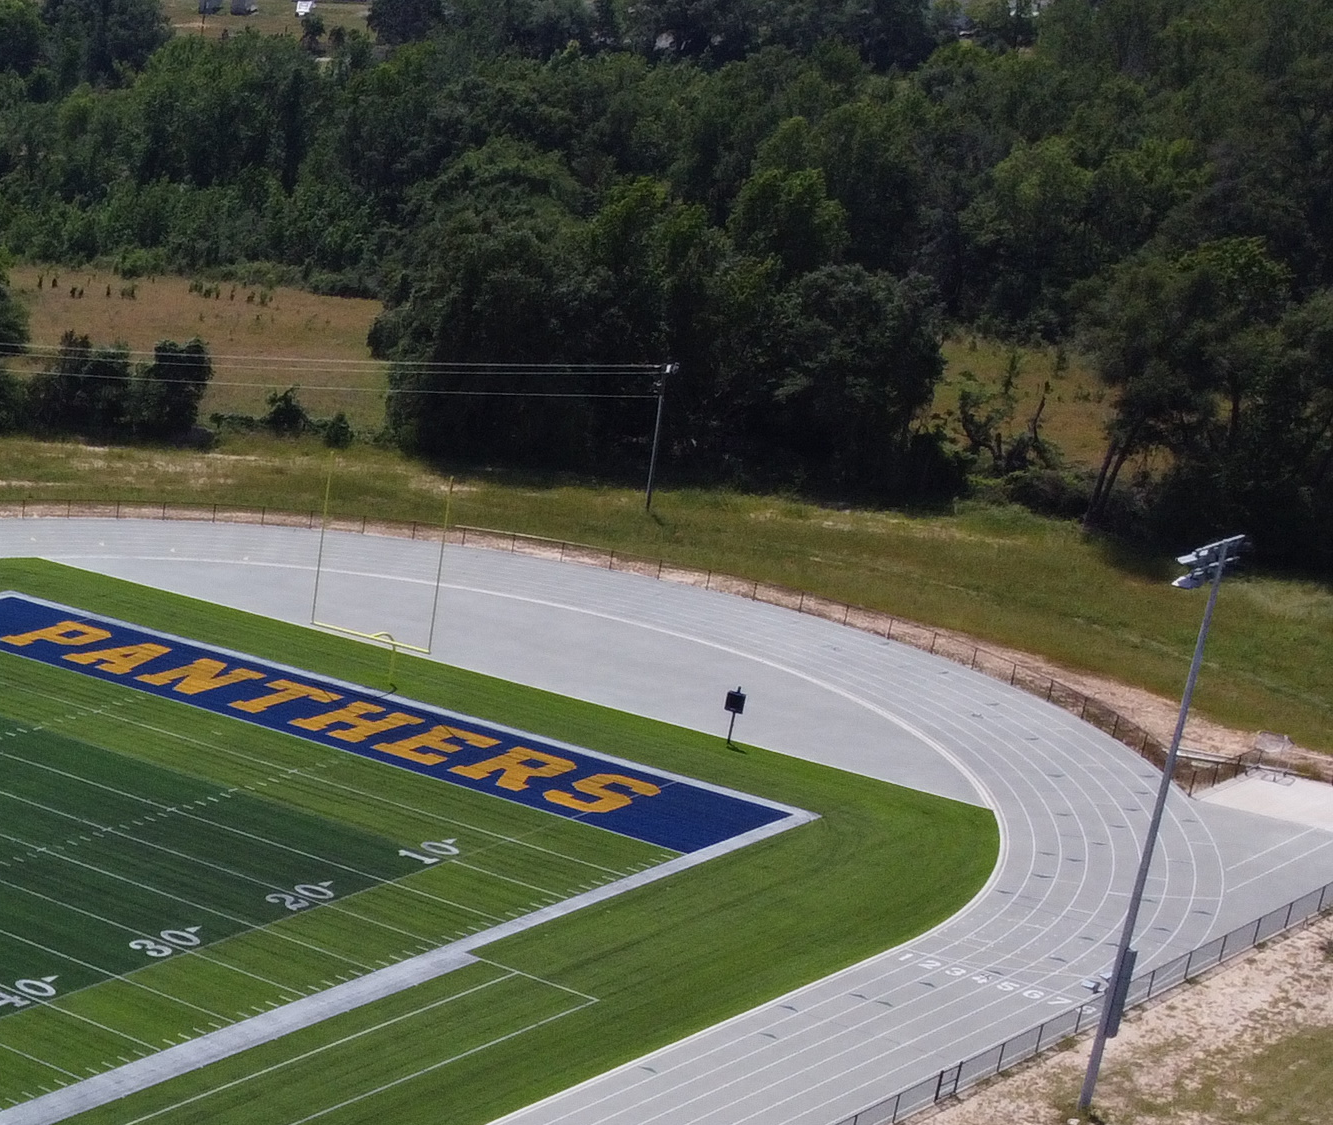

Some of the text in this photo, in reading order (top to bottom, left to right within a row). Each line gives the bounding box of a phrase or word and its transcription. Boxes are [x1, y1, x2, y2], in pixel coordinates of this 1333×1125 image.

[0, 619, 662, 814] PANTHERS
[398, 840, 459, 865] 10
[265, 882, 333, 912] 20
[129, 928, 200, 959] 30
[898, 953, 914, 961] 1
[918, 960, 941, 970] 2
[945, 966, 966, 976] 3
[996, 981, 1020, 991] 5
[1022, 989, 1045, 999] 6
[1047, 996, 1072, 1006] 7
